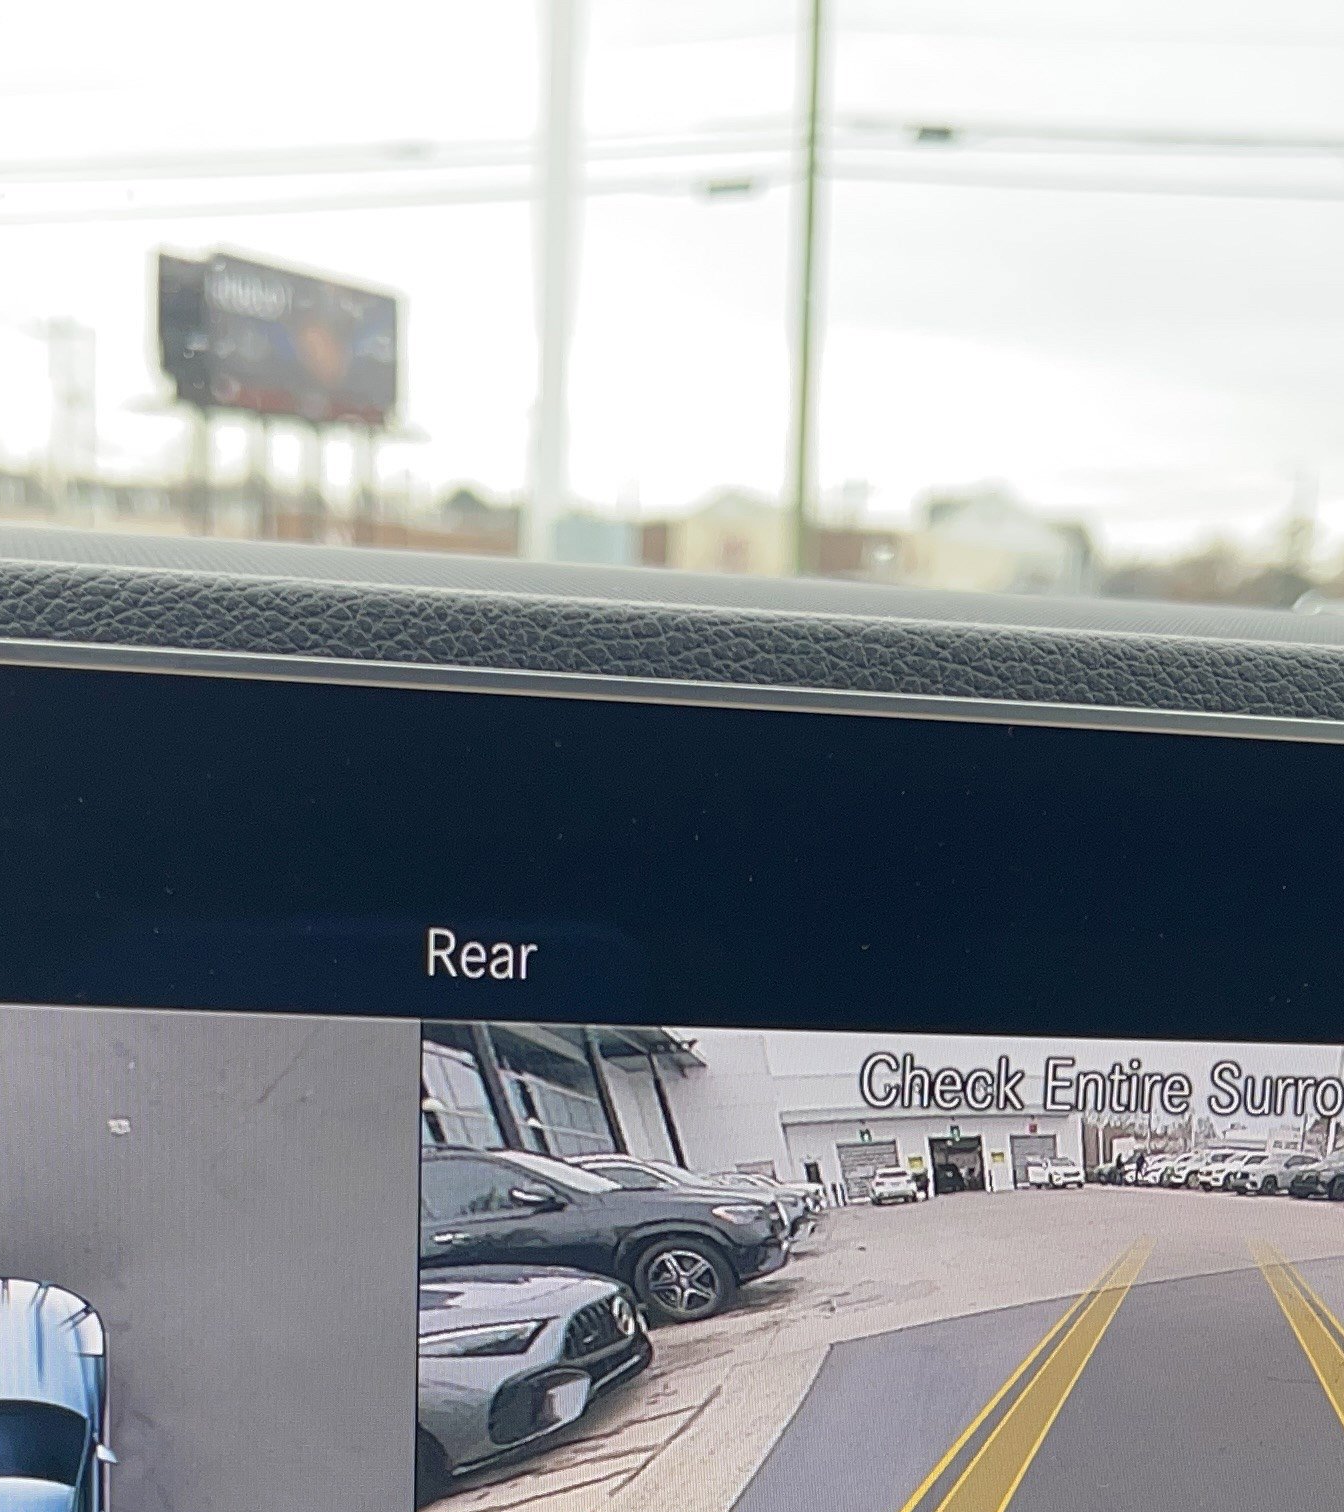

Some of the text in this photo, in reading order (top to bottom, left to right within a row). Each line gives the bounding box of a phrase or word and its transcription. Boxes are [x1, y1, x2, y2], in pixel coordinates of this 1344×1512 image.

[426, 925, 540, 981] Rear
[859, 1051, 1026, 1112] Check
[1043, 1055, 1193, 1115] Entire
